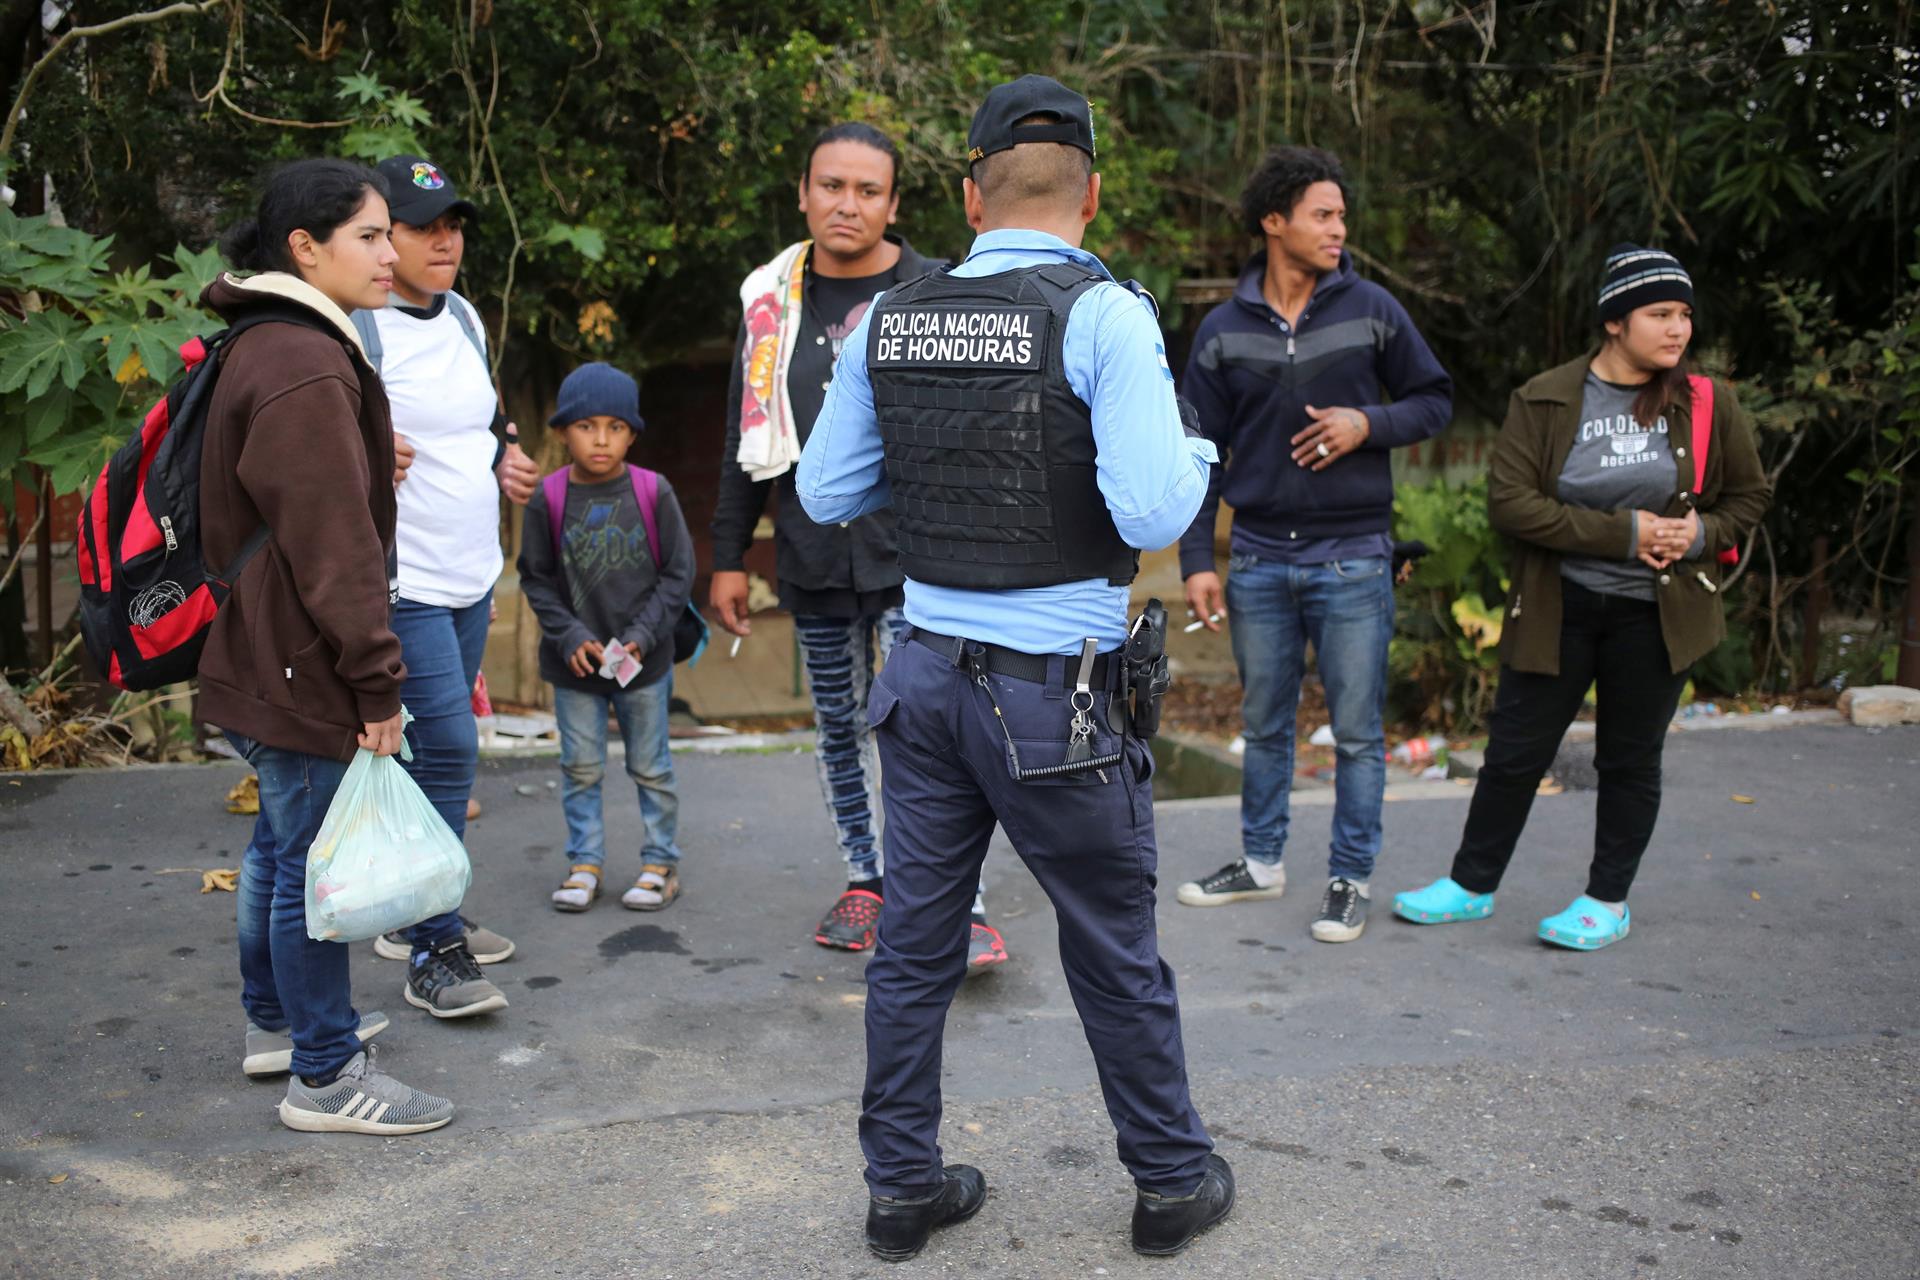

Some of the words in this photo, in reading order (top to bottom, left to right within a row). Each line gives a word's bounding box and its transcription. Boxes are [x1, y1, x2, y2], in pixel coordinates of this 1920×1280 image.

[880, 313, 940, 336] POLICIA
[944, 313, 1032, 338] NACIONAL
[877, 338, 903, 361] DE
[907, 338, 1032, 364] HONDURAS
[1582, 414, 1668, 441] COLORD
